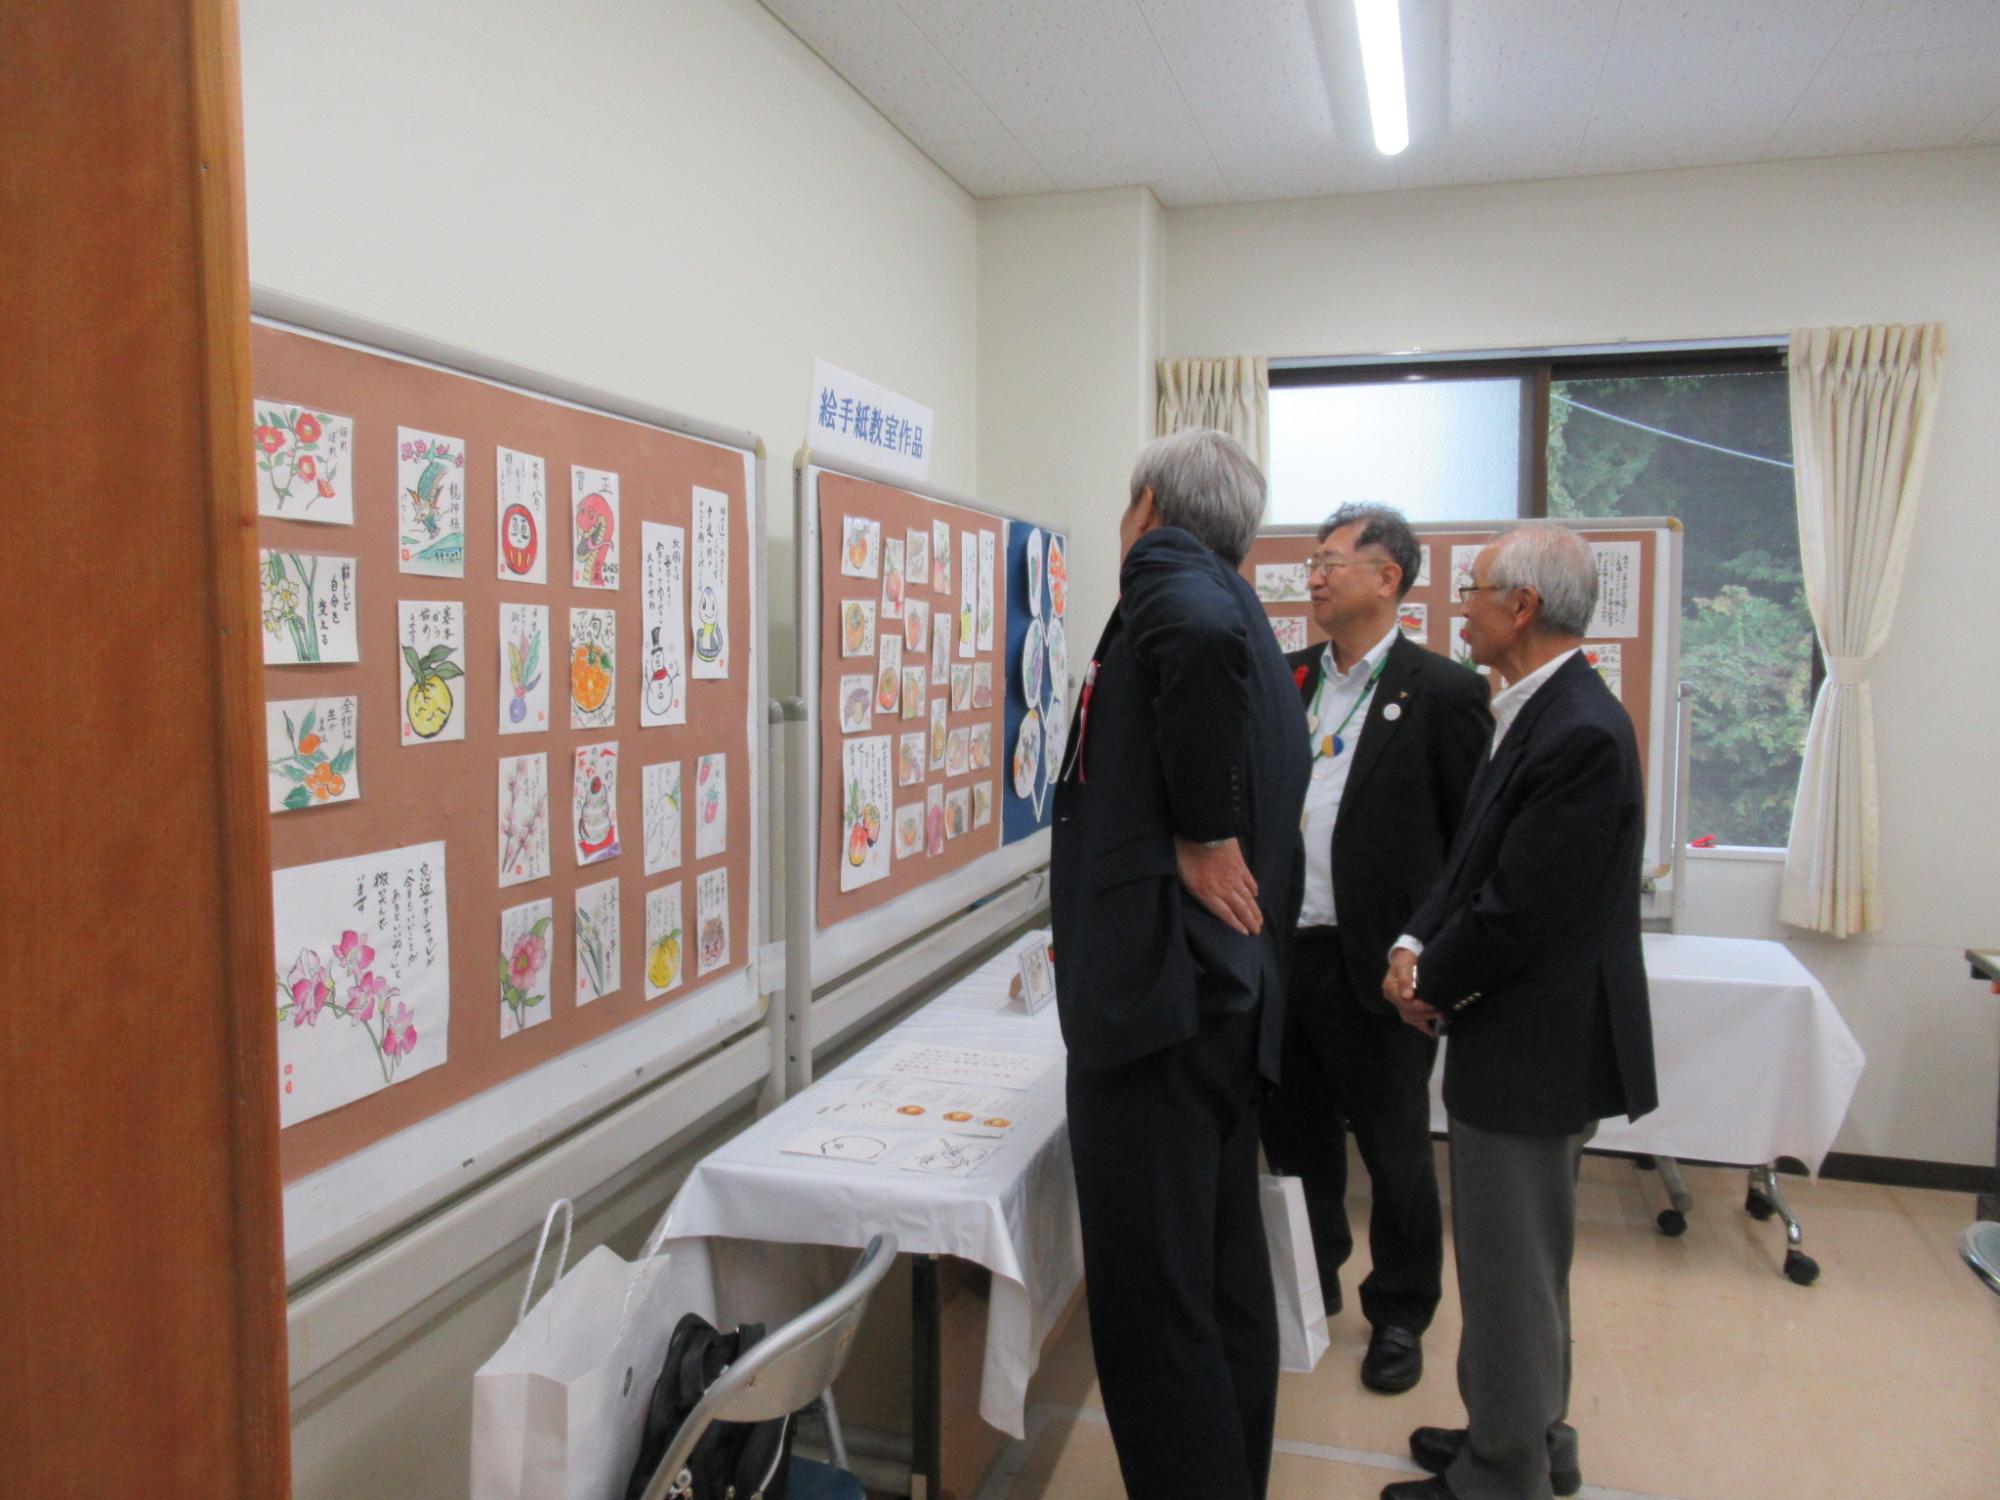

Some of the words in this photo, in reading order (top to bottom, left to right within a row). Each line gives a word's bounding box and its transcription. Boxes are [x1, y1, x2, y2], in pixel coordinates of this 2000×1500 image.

[819, 387, 923, 458] 絵手紙教室作品
